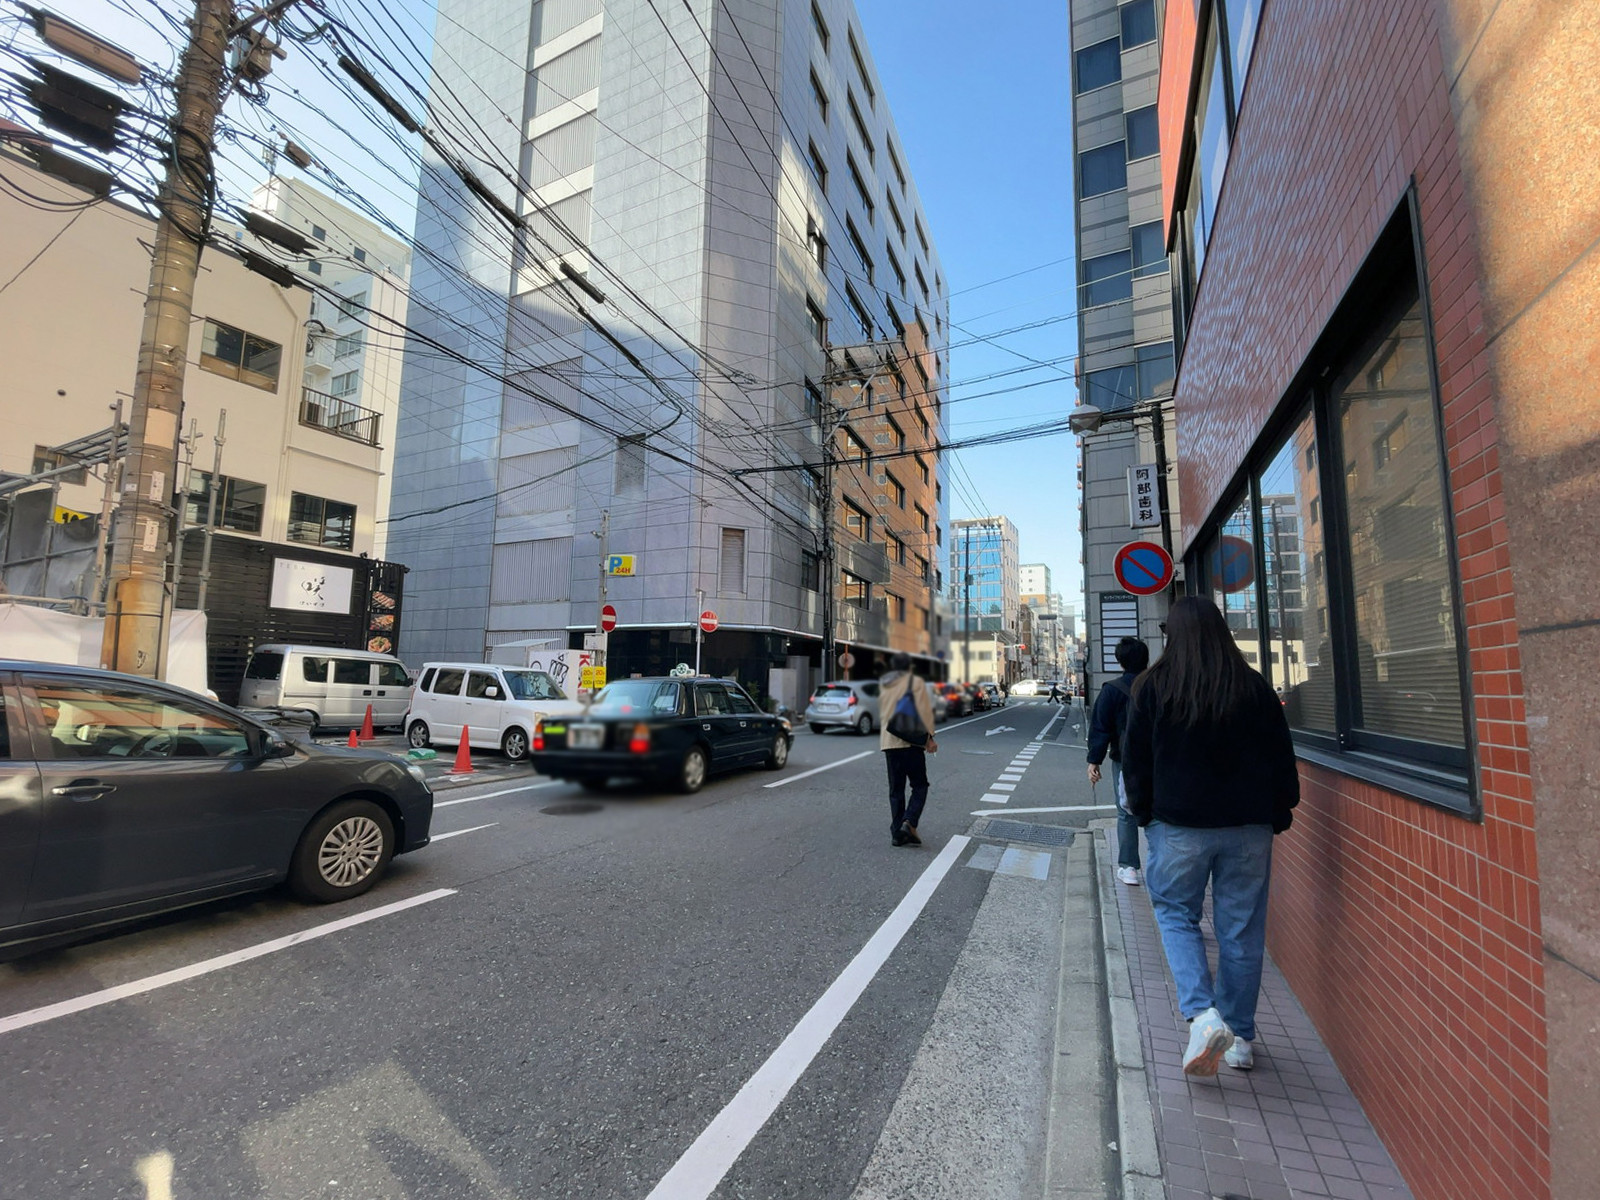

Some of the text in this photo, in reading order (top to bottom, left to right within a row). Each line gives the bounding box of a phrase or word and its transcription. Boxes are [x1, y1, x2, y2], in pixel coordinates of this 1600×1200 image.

[1135, 468, 1154, 522] 阿部歯科
[609, 556, 623, 573] P
